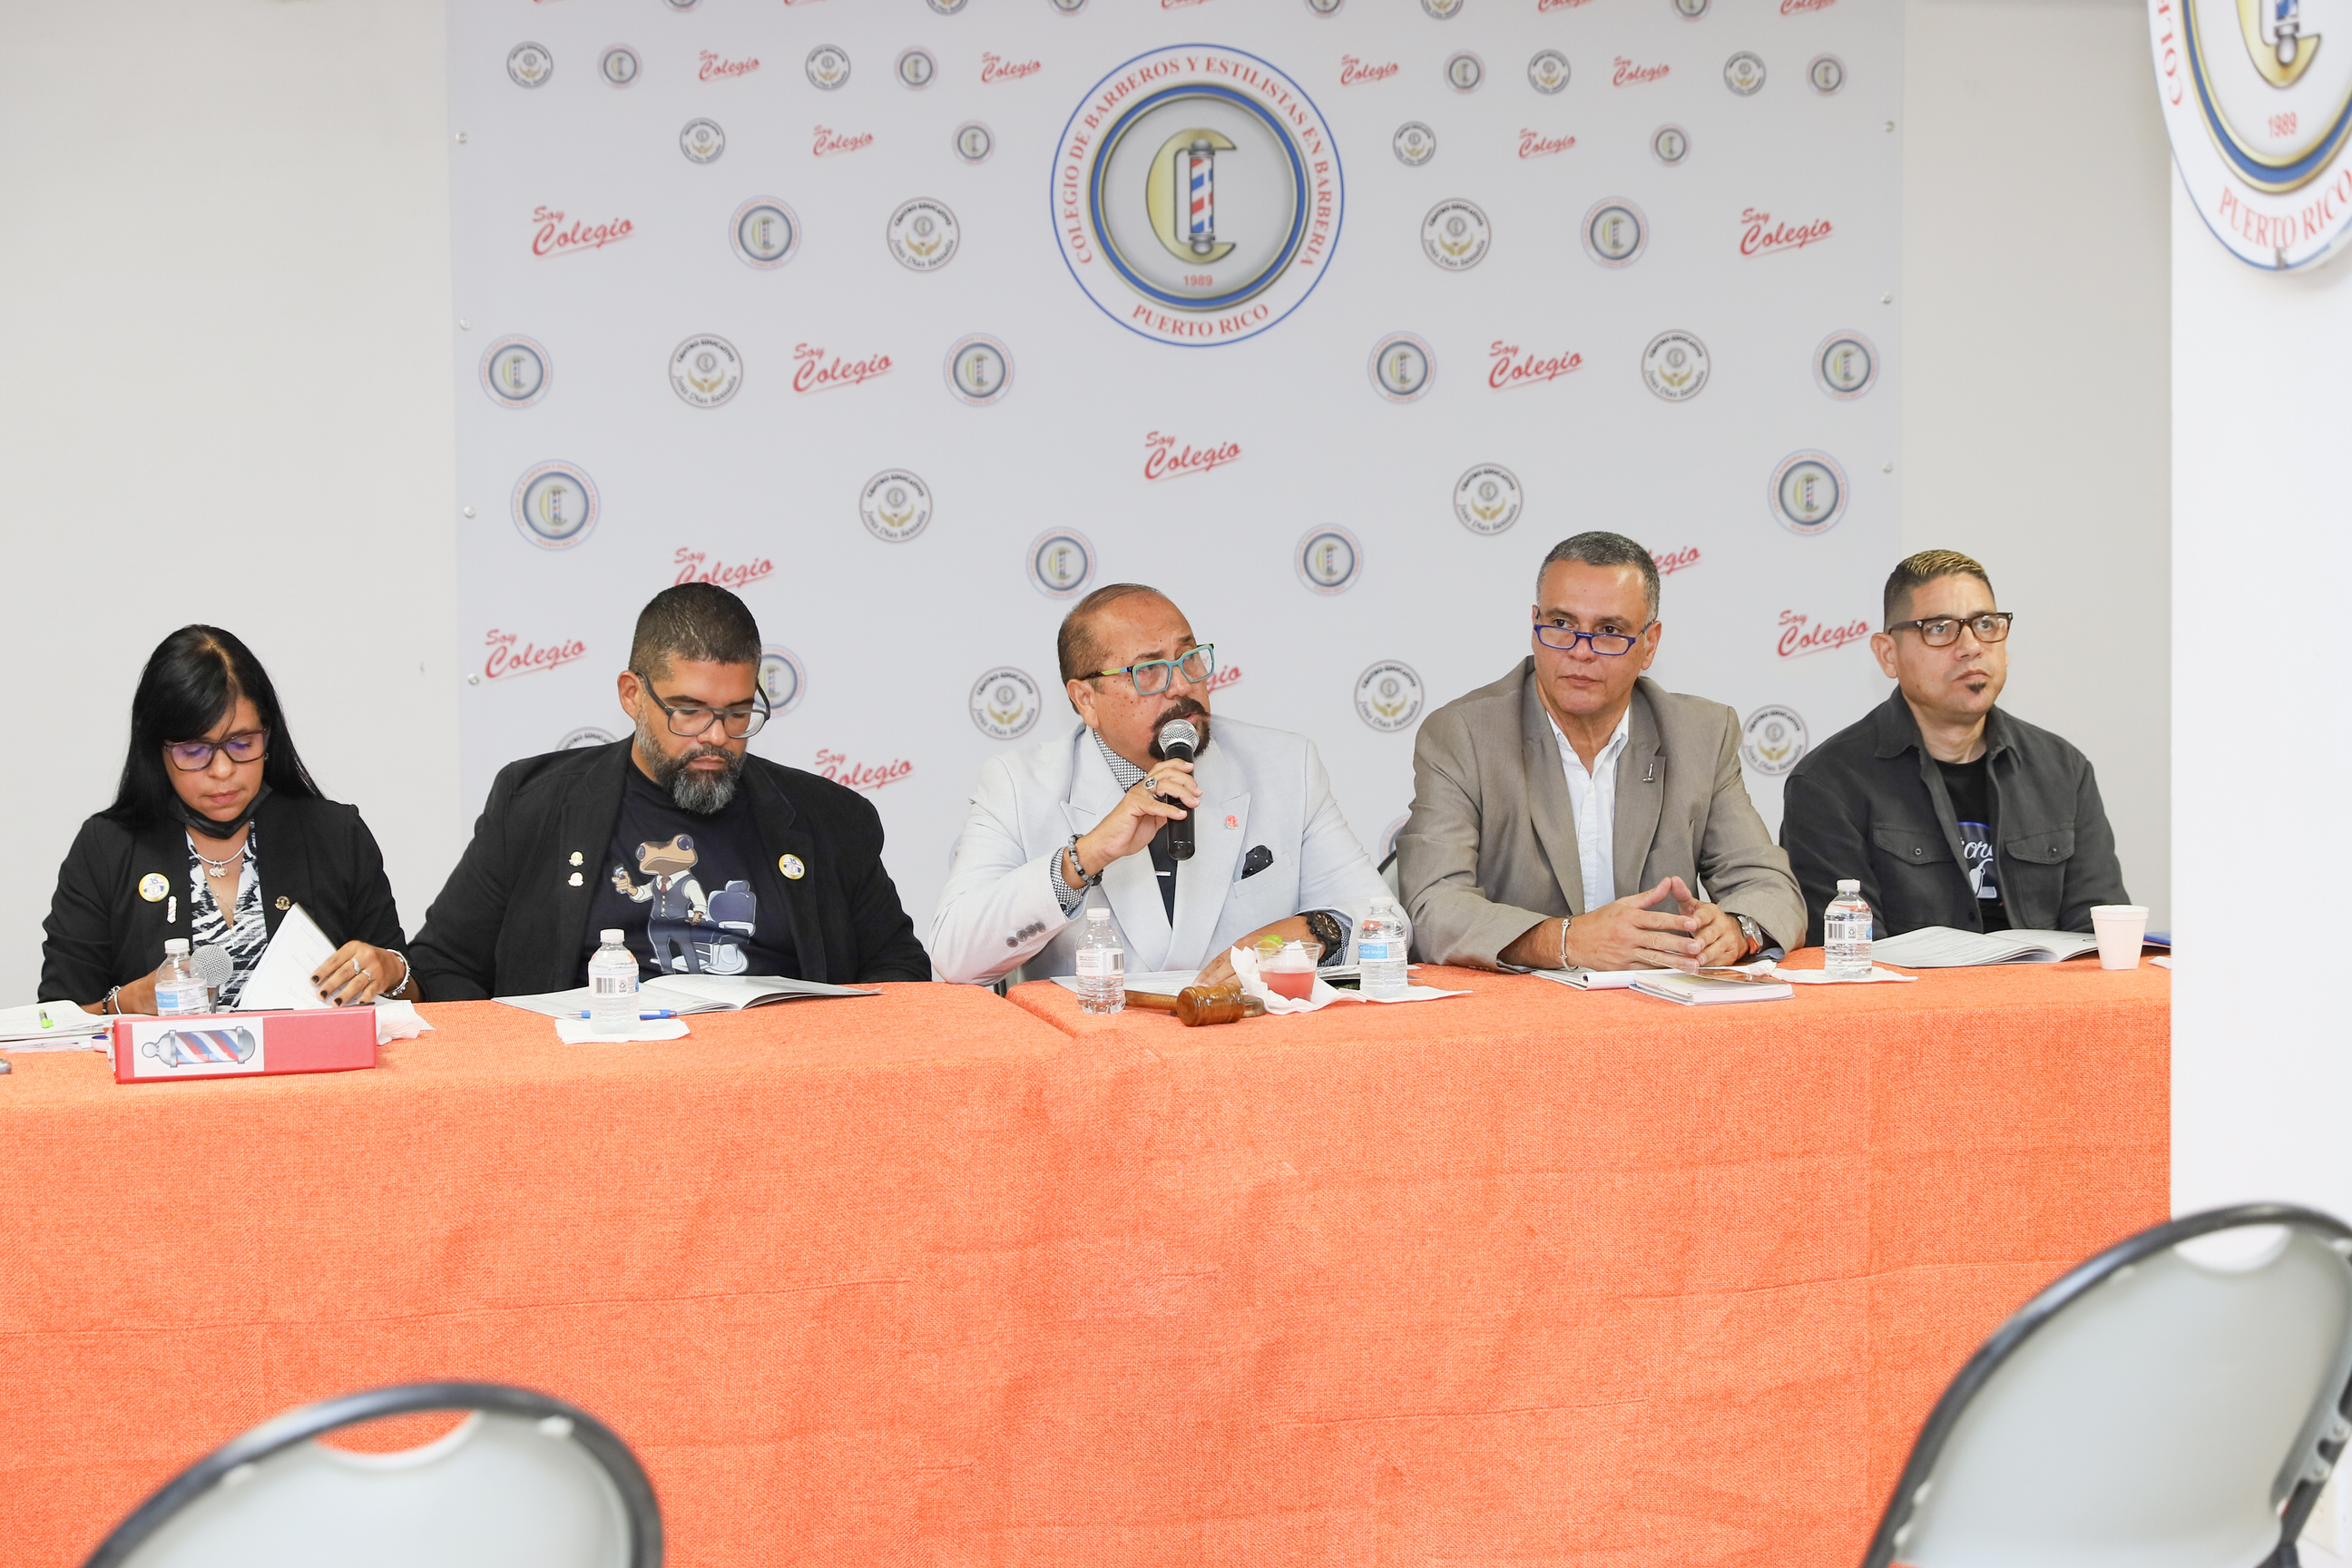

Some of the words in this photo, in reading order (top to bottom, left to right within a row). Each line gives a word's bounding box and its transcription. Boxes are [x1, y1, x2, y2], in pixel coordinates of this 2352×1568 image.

[699, 57, 760, 81] Colegio
[981, 59, 1041, 83] Colegio
[1186, 56, 1200, 72] Y
[1340, 62, 1399, 85] Colegio
[1612, 63, 1671, 86] Colegio
[1084, 58, 1180, 129] BARBEROS
[1206, 57, 1307, 127] ESTILISTAS
[2269, 113, 2298, 138] 1989
[812, 132, 873, 155] Colegio
[1069, 132, 1091, 160] DE
[1303, 127, 1325, 155] EN
[1519, 135, 1577, 159] Colegio
[533, 205, 565, 224] Soy
[1063, 164, 1093, 264] COLEGIO
[1299, 161, 1332, 265] BARBERIA
[1741, 208, 1770, 225] Soy
[2220, 186, 2297, 249] PUERTO
[2302, 170, 2352, 240] RICO
[532, 217, 634, 257] Colegio
[1740, 218, 1833, 257] Colegio
[1183, 275, 1212, 287] 1989
[1132, 304, 1212, 338] PUERTO
[1220, 304, 1269, 335] RICO
[794, 343, 824, 360] Soy
[1490, 340, 1519, 358] Soy
[792, 353, 893, 393] Colegio
[1488, 350, 1583, 389] Colegio
[1145, 431, 1176, 448] Soy
[1143, 439, 1241, 480] Colegio
[674, 546, 706, 564] Soy
[1779, 610, 1808, 627] Soy
[485, 629, 517, 646] Soy
[1777, 618, 1870, 657] Colegio
[485, 639, 587, 679] Colegio
[815, 749, 846, 765] Soy
